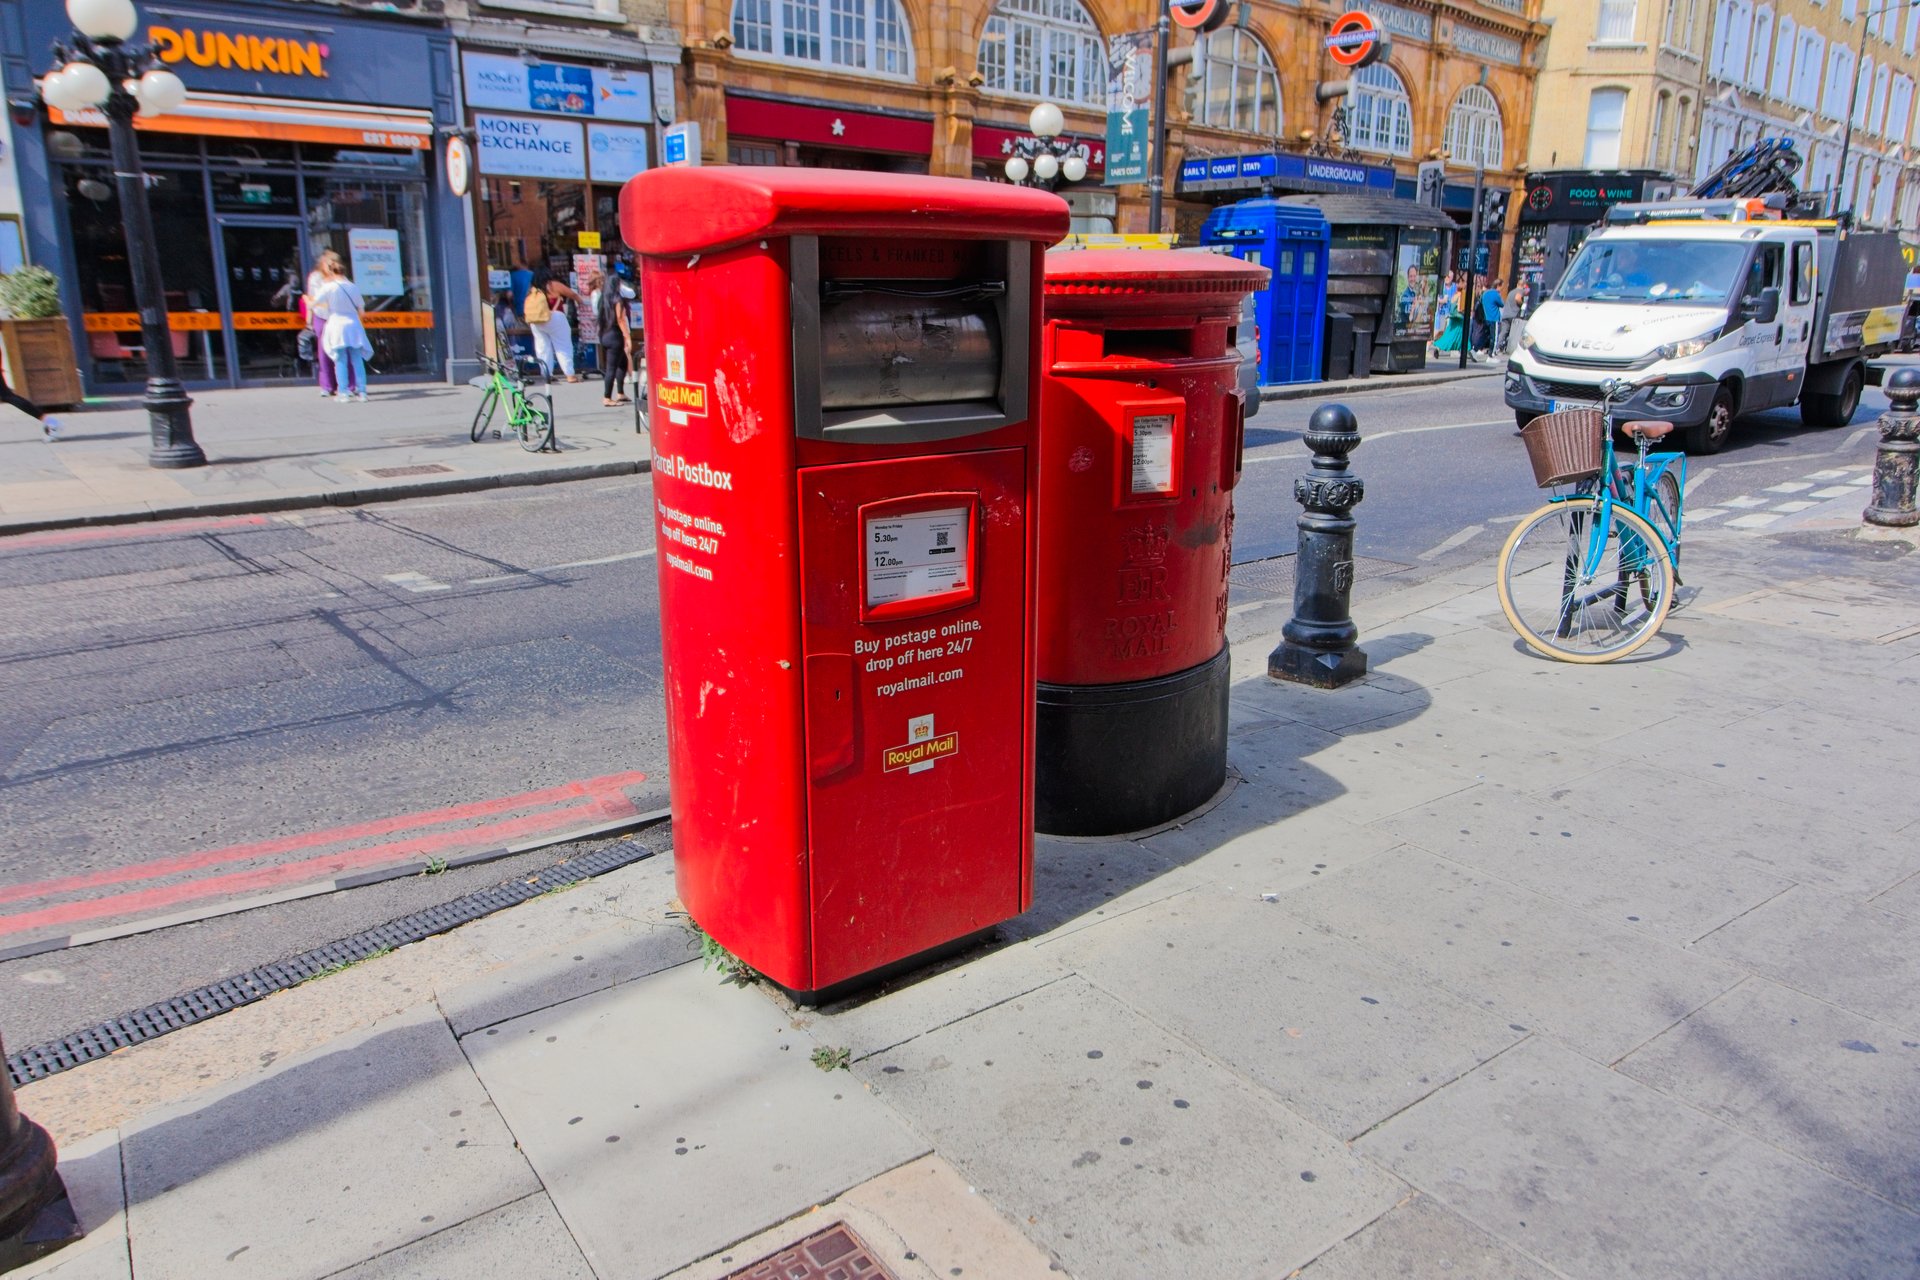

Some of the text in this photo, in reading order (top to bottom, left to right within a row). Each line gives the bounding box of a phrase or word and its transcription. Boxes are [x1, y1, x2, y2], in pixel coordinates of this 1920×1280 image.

[1368, 5, 1420, 34] PICCADILLY
[1421, 18, 1429, 35] &
[1326, 31, 1377, 46] UNDERGROUND
[1453, 27, 1521, 61] BROMPTON RAILWAY
[148, 26, 330, 77] DUNKIN'
[478, 71, 521, 84] MONEY
[1122, 46, 1137, 135] WELCOME
[480, 119, 541, 135] MONEY
[482, 136, 572, 154] EXCHANGE
[1184, 166, 1205, 176] EARL'S
[1212, 164, 1236, 175] COURT
[1308, 164, 1365, 183] UNDERGROUND
[1569, 188, 1597, 198] FOOD
[1607, 189, 1633, 199] WINE
[887, 249, 944, 263] FRANKED
[1423, 249, 1434, 266] tlc
[1564, 338, 1616, 351] IVECO
[1739, 333, 1775, 347] Carpet Express
[658, 384, 703, 407] Royal Mail
[677, 457, 732, 490] Postbox
[667, 508, 692, 528] postage
[694, 514, 726, 537] online,
[673, 527, 681, 542] off
[681, 530, 697, 548] here
[699, 536, 718, 555] 24/7
[874, 532, 899, 543] 5.30pm
[666, 552, 712, 581] royalmail.com
[874, 556, 903, 568] 12.00pm
[854, 619, 982, 654] Buy postage online,
[1105, 610, 1178, 639] ROYAL
[866, 637, 973, 673] drop off here 24/7
[1113, 636, 1170, 661] MAIL
[876, 667, 964, 697] royalmail.com
[888, 736, 953, 765] Royal Mail
